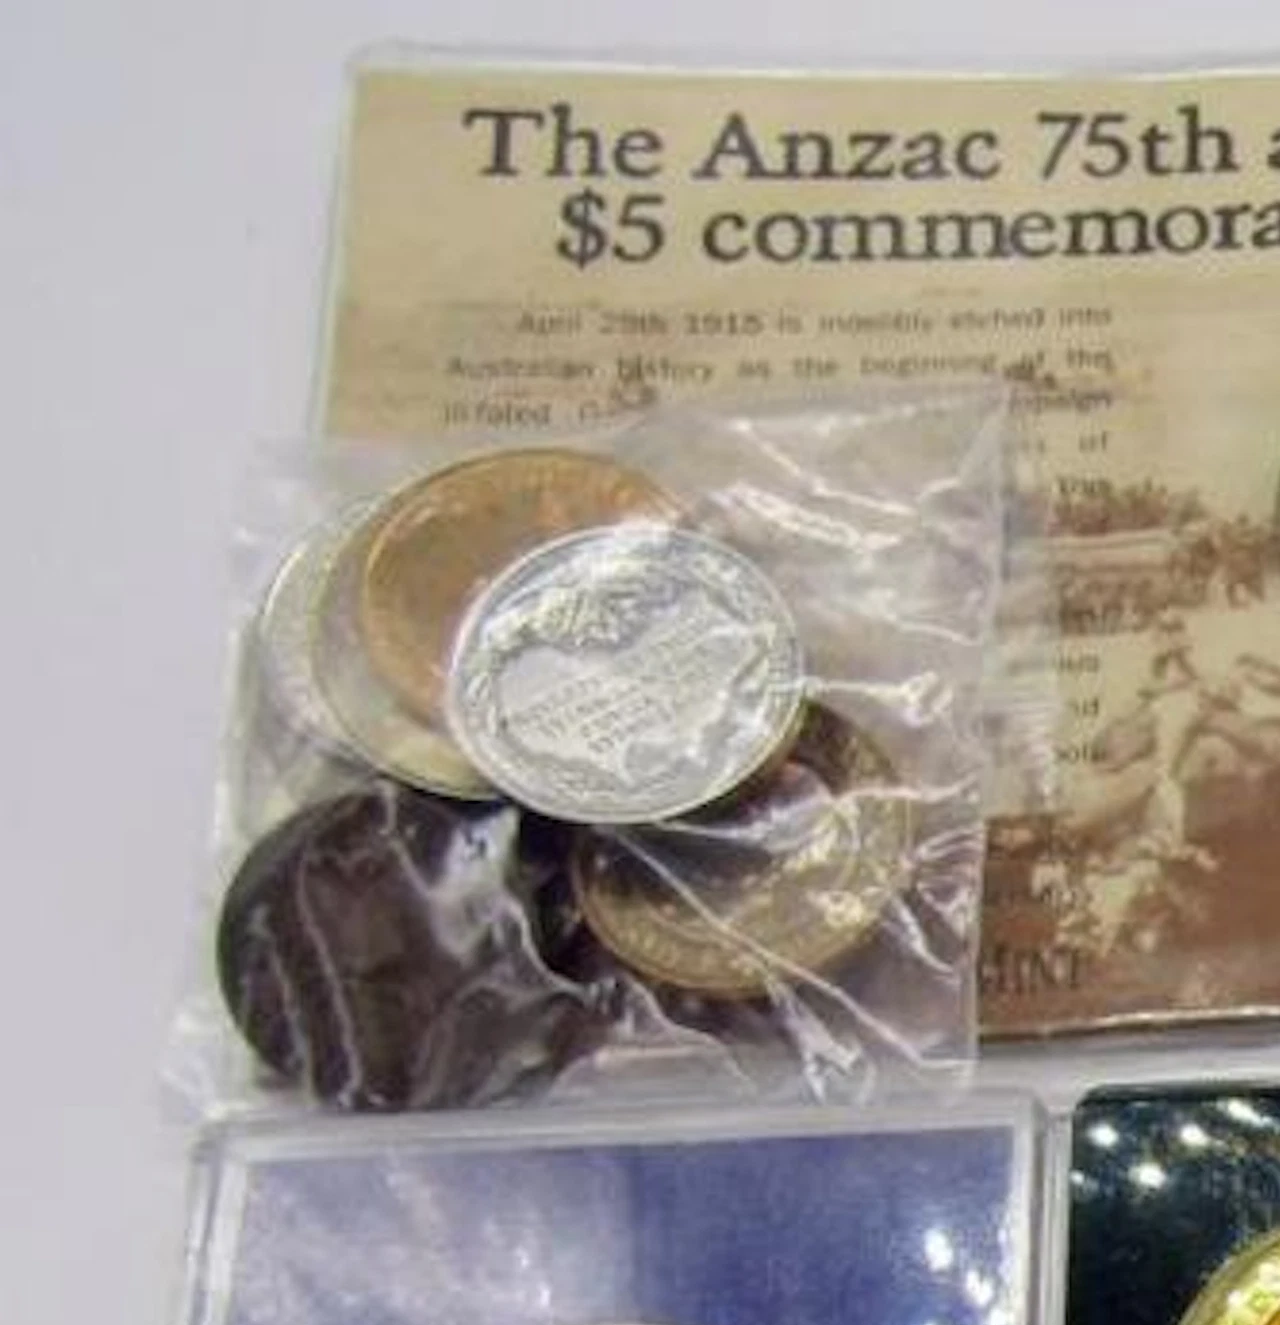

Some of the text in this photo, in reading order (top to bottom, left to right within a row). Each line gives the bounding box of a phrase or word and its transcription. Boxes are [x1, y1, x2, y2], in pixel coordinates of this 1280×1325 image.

[463, 104, 664, 179] The
[694, 111, 999, 181] Anzac
[1035, 107, 1238, 180] 75th
[555, 188, 665, 269] $5
